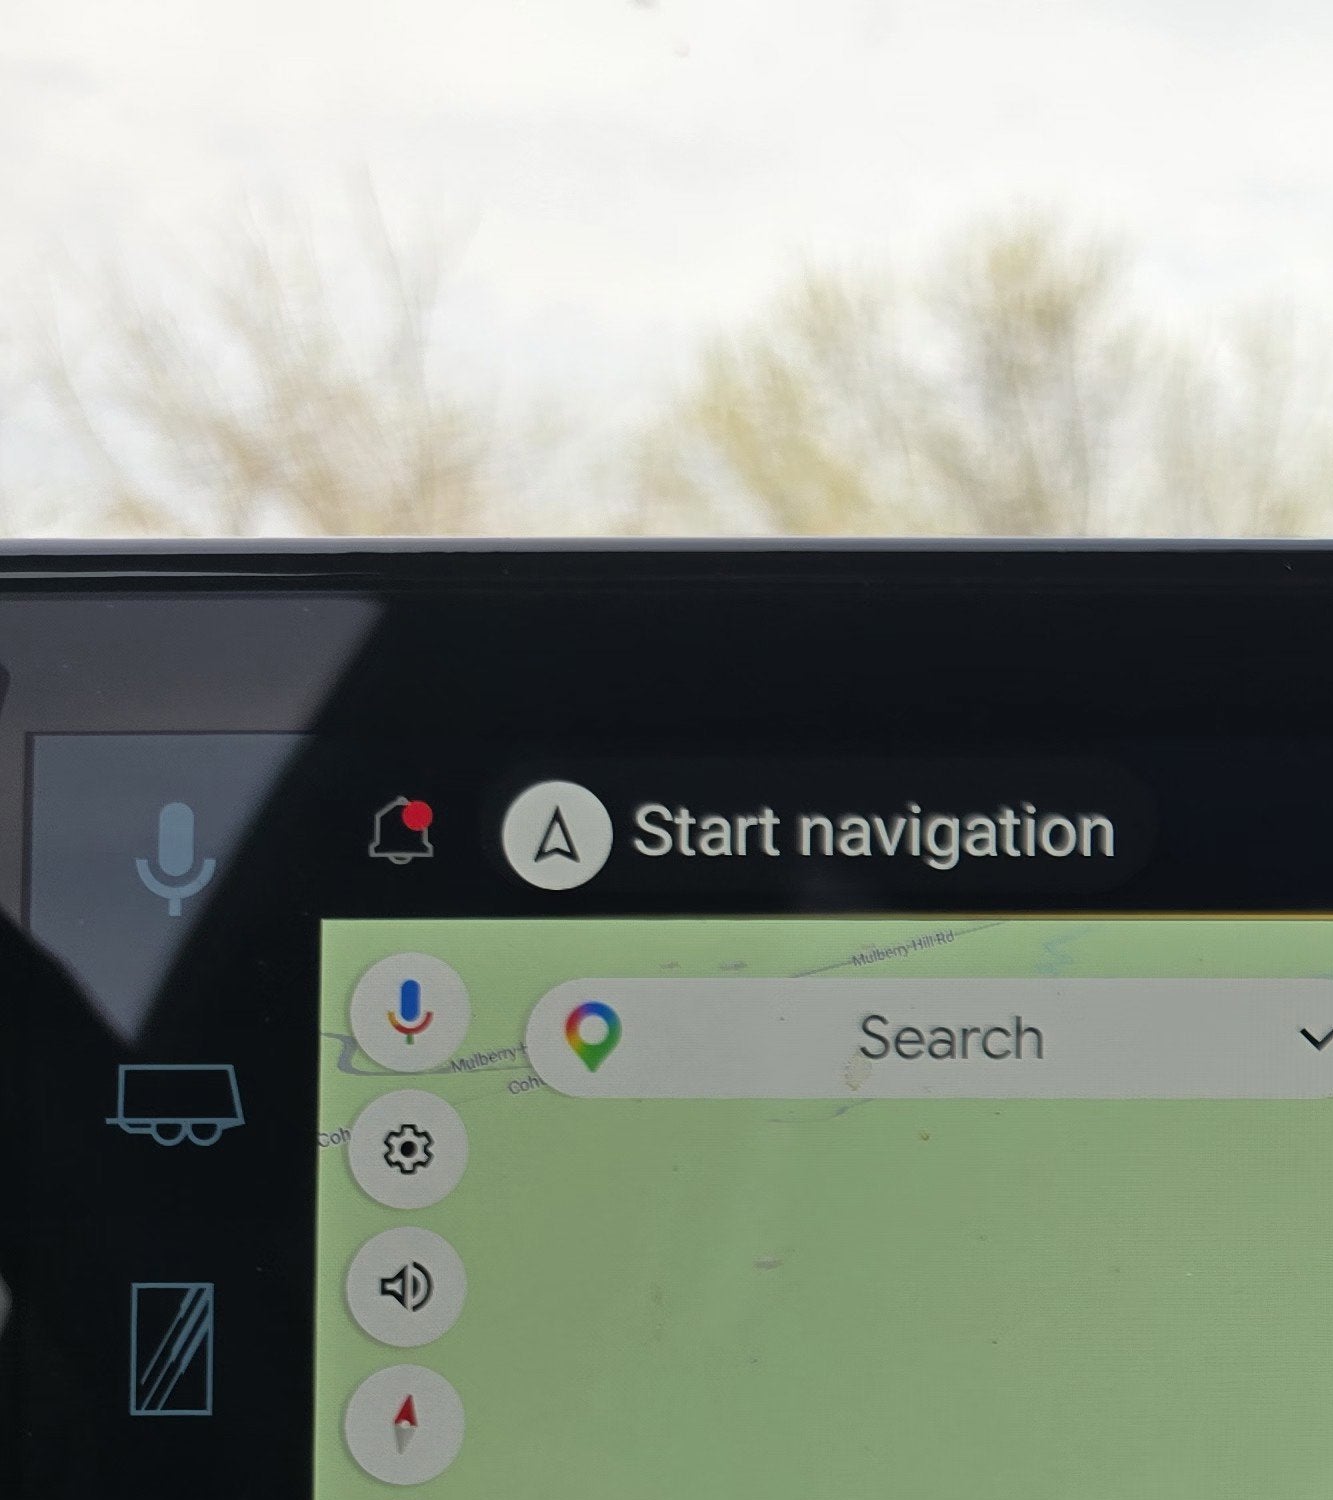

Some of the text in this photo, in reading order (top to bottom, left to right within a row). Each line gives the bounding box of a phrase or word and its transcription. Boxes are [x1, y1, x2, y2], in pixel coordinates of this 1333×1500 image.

[634, 801, 1115, 870] Start navigation
[852, 928, 955, 967] Mulberry Hill Rd
[859, 1013, 1045, 1061] Search
[451, 1045, 517, 1074] Mulberry
